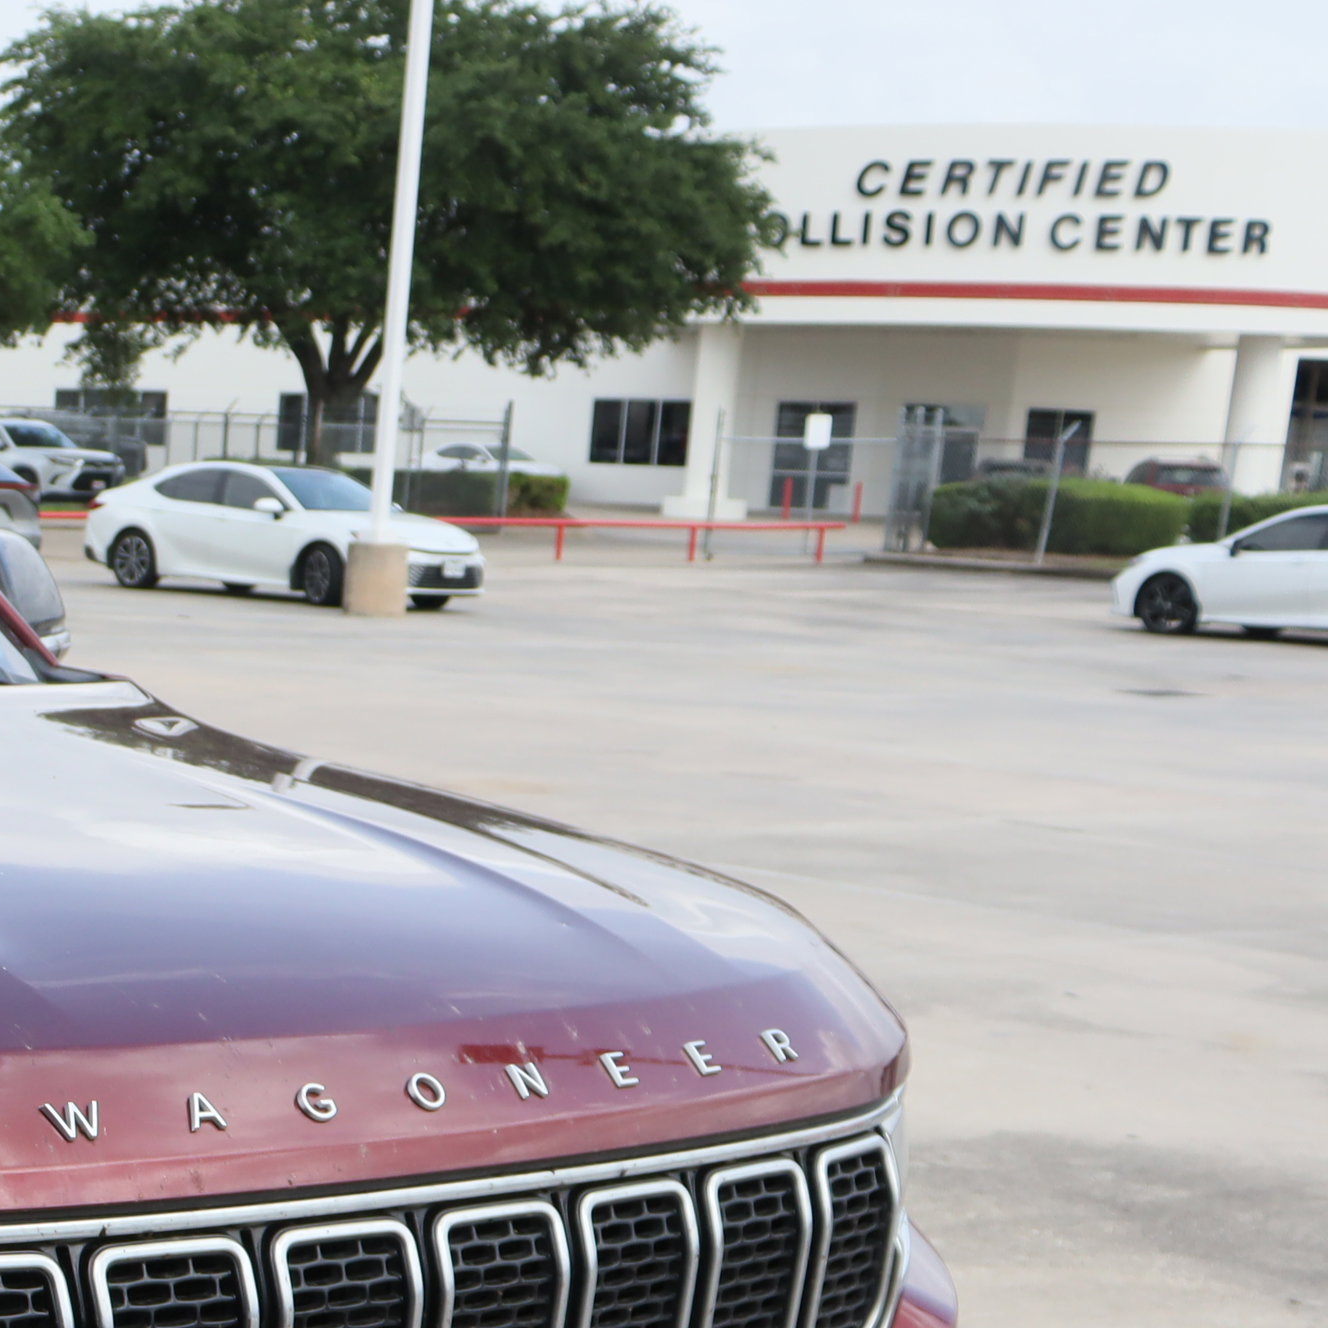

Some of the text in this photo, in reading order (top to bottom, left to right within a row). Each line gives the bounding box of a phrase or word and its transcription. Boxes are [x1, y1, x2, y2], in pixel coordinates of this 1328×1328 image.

[856, 158, 1172, 199] CERTIFIED
[765, 209, 1271, 256] OLLISION CENTER
[37, 1025, 801, 1144] WAGONEER
